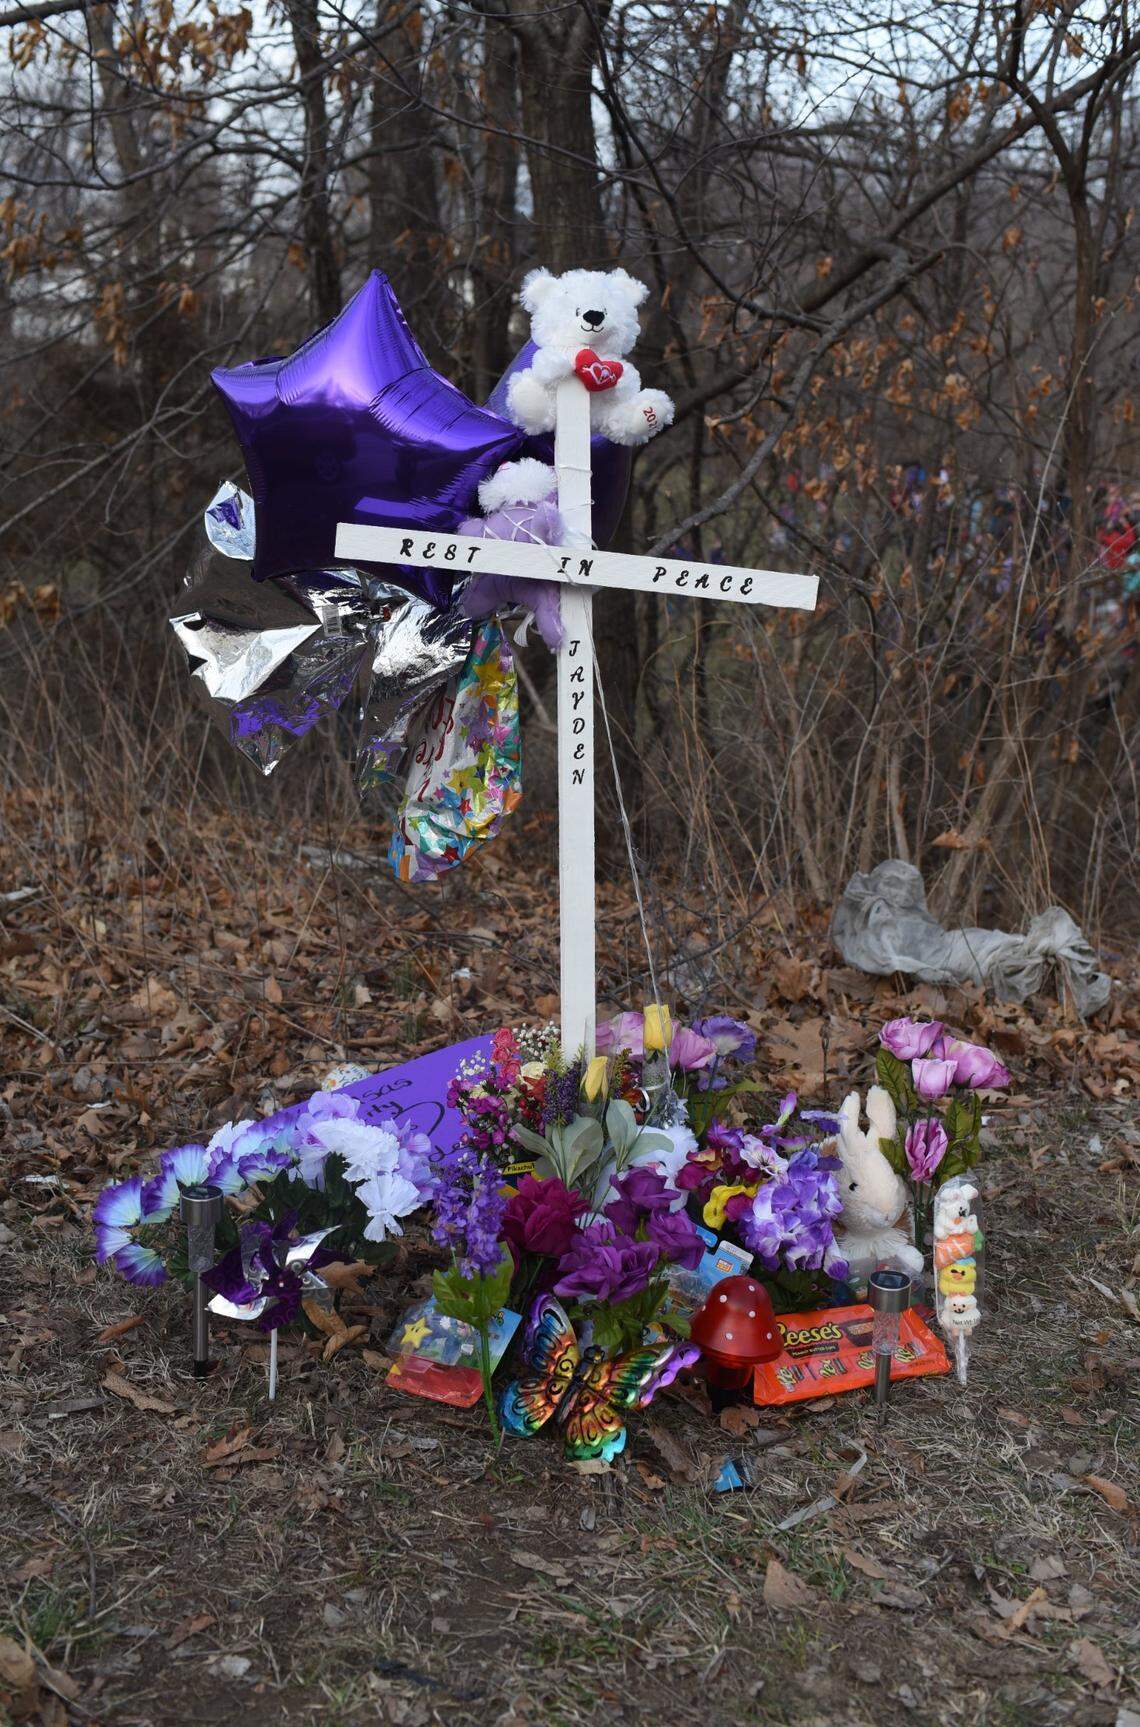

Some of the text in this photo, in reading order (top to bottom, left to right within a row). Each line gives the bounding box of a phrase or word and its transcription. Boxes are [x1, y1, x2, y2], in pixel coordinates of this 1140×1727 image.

[400, 538, 753, 595] REST IN PEACE
[569, 640, 586, 785] JAYDEN
